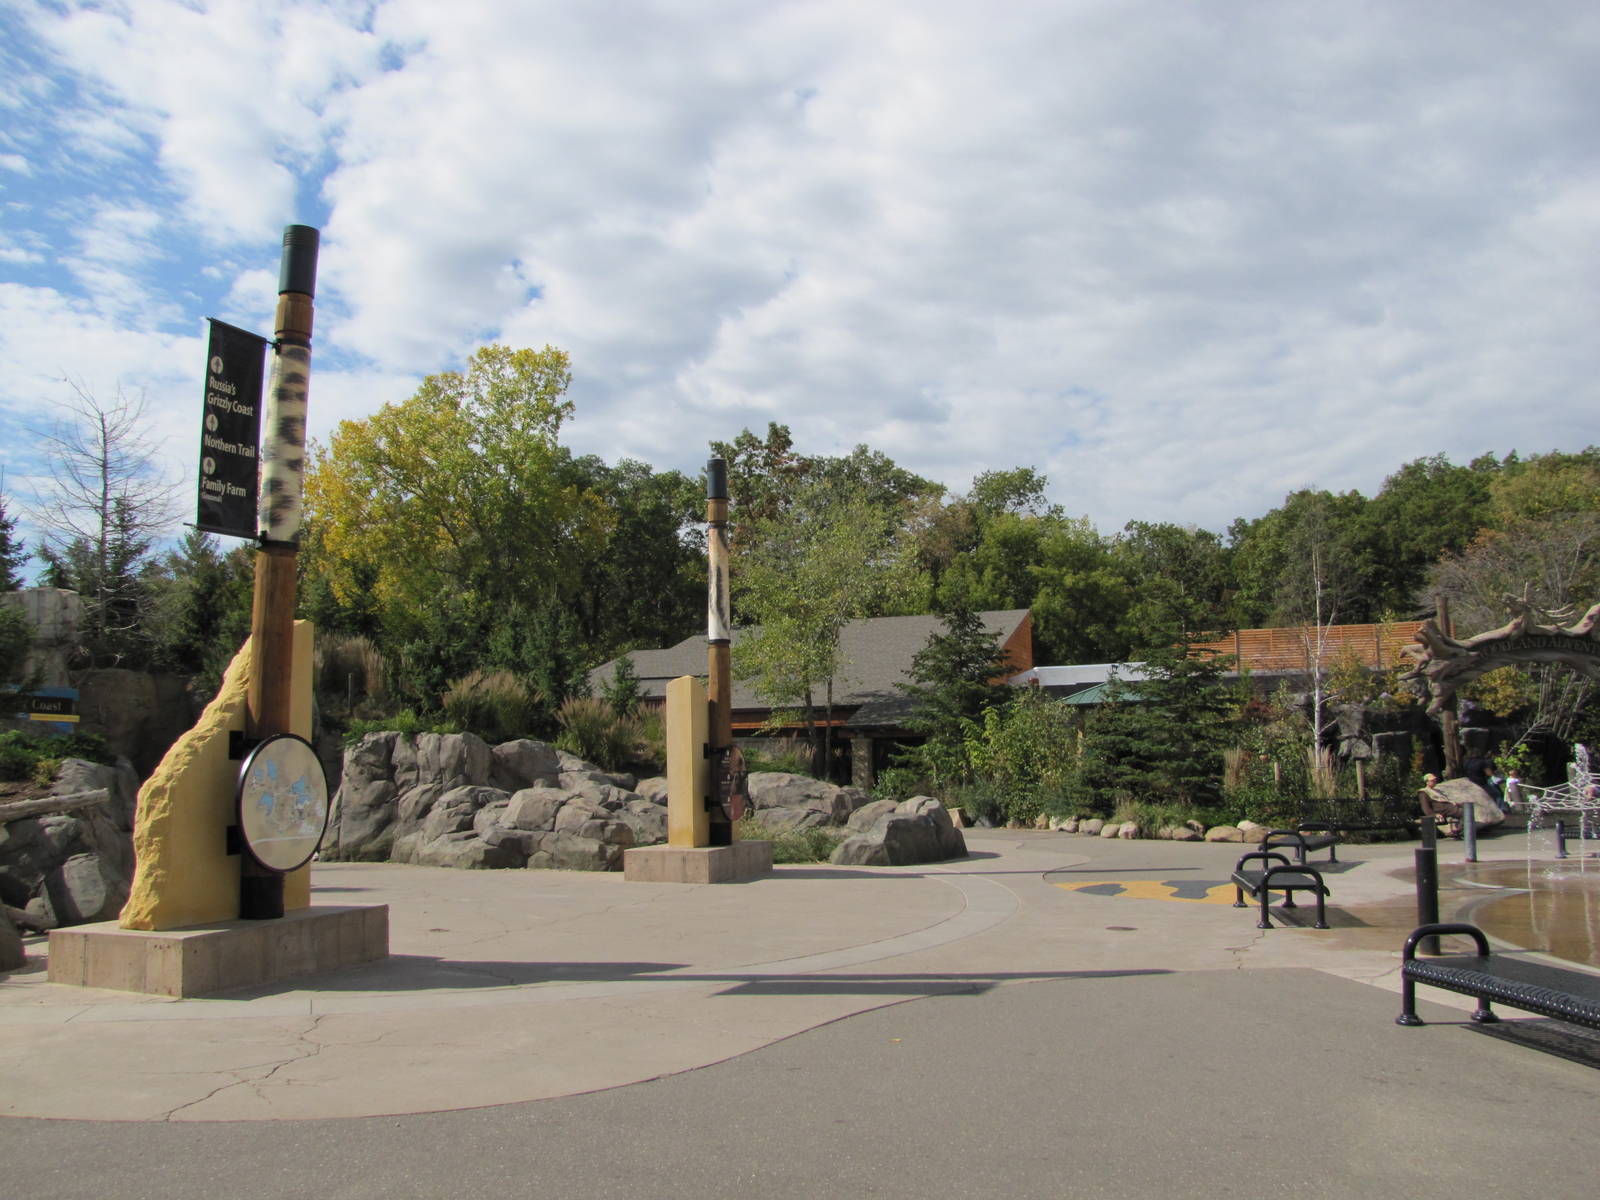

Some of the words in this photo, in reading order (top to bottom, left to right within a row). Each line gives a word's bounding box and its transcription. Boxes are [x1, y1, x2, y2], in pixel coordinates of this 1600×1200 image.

[209, 376, 236, 396] Russia's
[207, 392, 232, 413] Grizzly
[232, 400, 254, 417] Coast
[204, 434, 237, 454] Northern
[237, 443, 256, 457] Trail
[202, 477, 225, 496] Family
[226, 482, 246, 496] Farm
[32, 699, 62, 711] Coast
